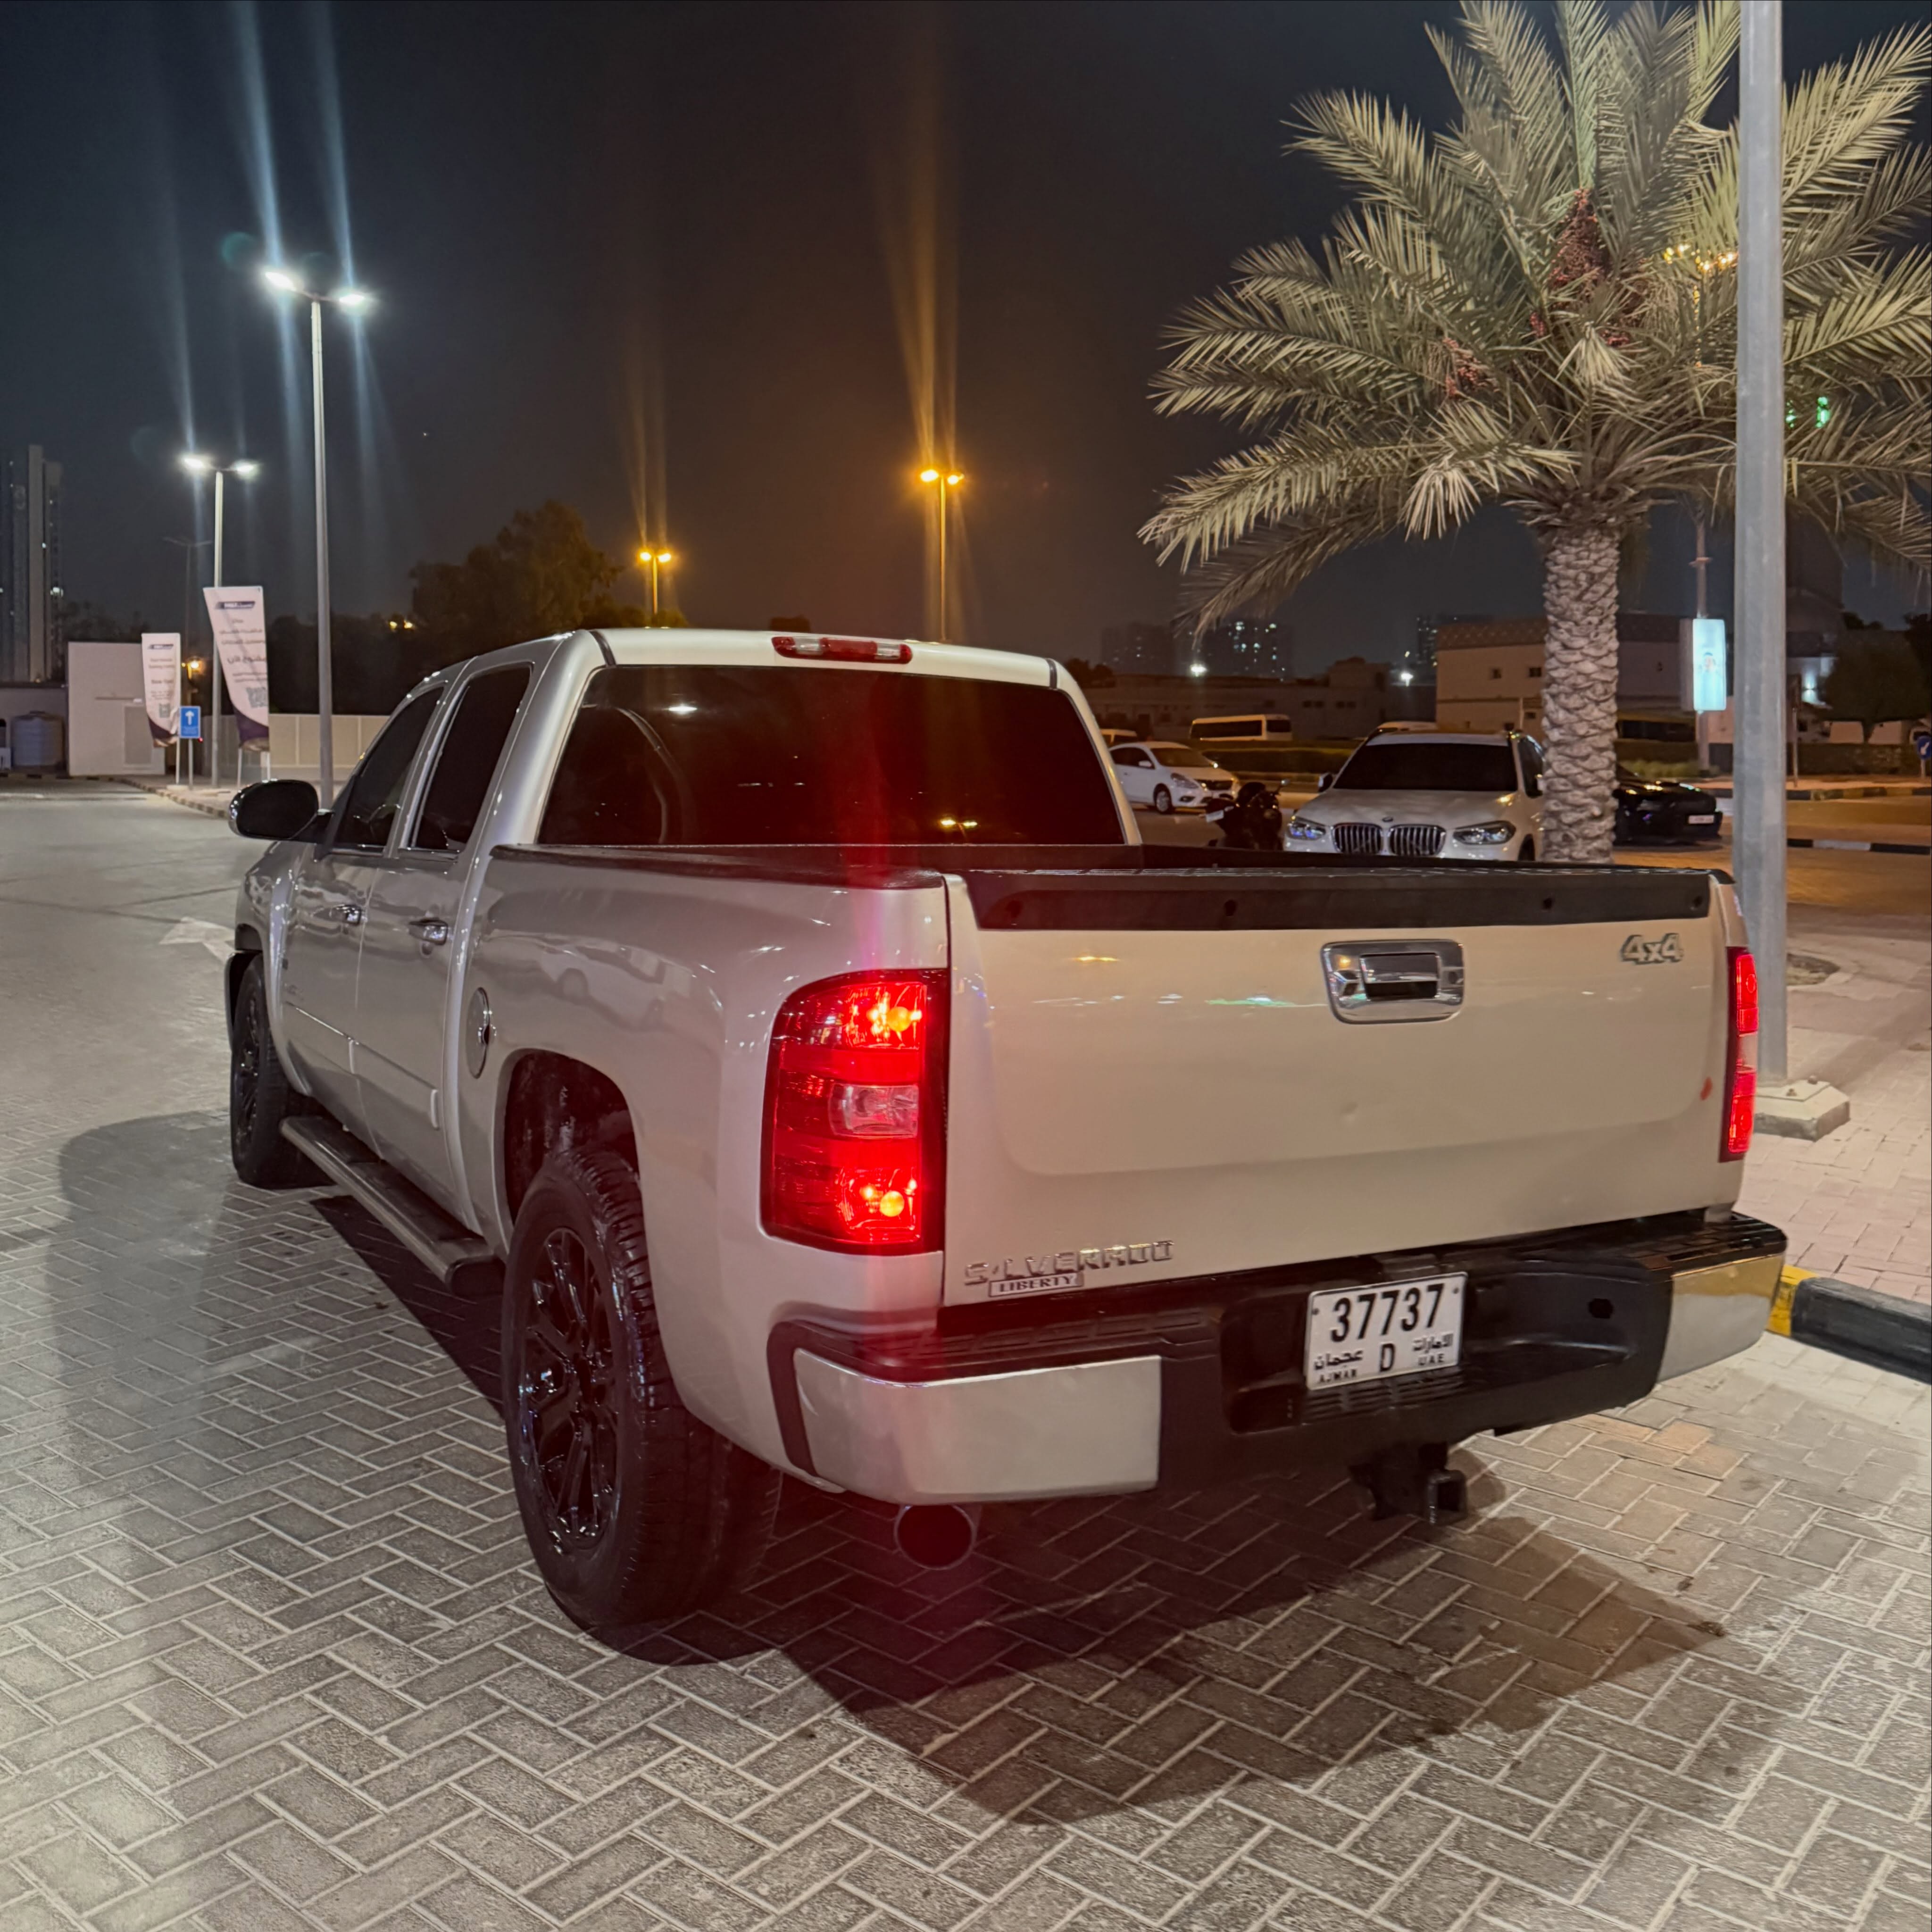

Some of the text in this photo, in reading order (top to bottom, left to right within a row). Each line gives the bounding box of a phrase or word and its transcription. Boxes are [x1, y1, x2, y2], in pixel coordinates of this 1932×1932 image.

[999, 1275, 1074, 1293] LIBERTY
[1330, 1283, 1445, 1342] 37737
[1314, 1350, 1363, 1370] عجمان
[1379, 1343, 1396, 1373] D
[1418, 1353, 1444, 1366] UAE
